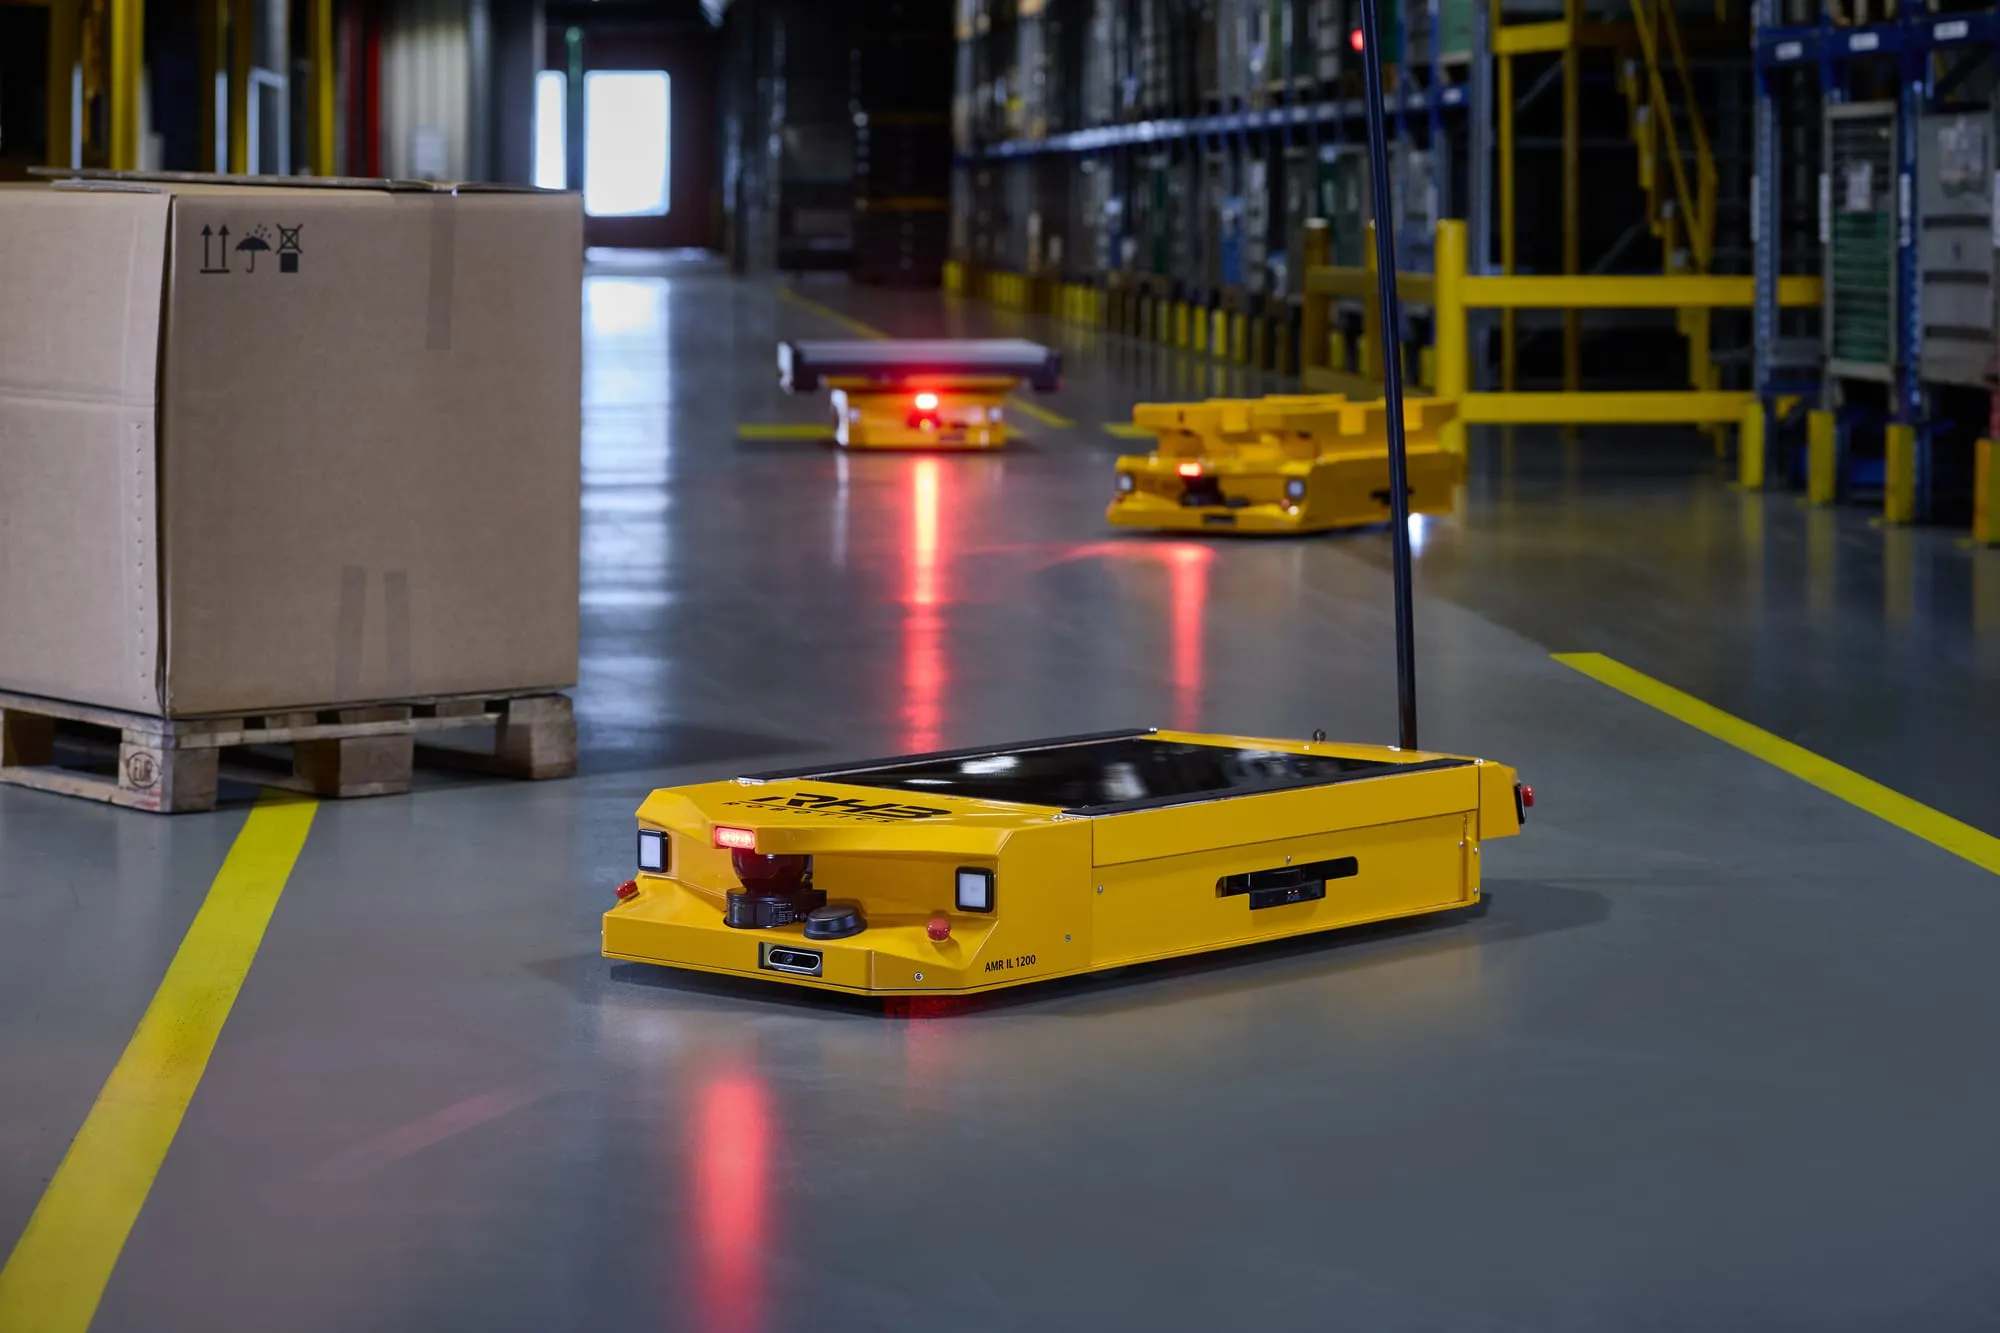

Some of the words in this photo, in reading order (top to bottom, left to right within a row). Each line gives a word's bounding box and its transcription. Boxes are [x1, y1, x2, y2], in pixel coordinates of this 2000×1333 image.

[722, 801, 897, 823] ROBOTICS
[984, 960, 1004, 972] AMR
[1006, 958, 1013, 969] IL
[1016, 955, 1036, 967] 1200
